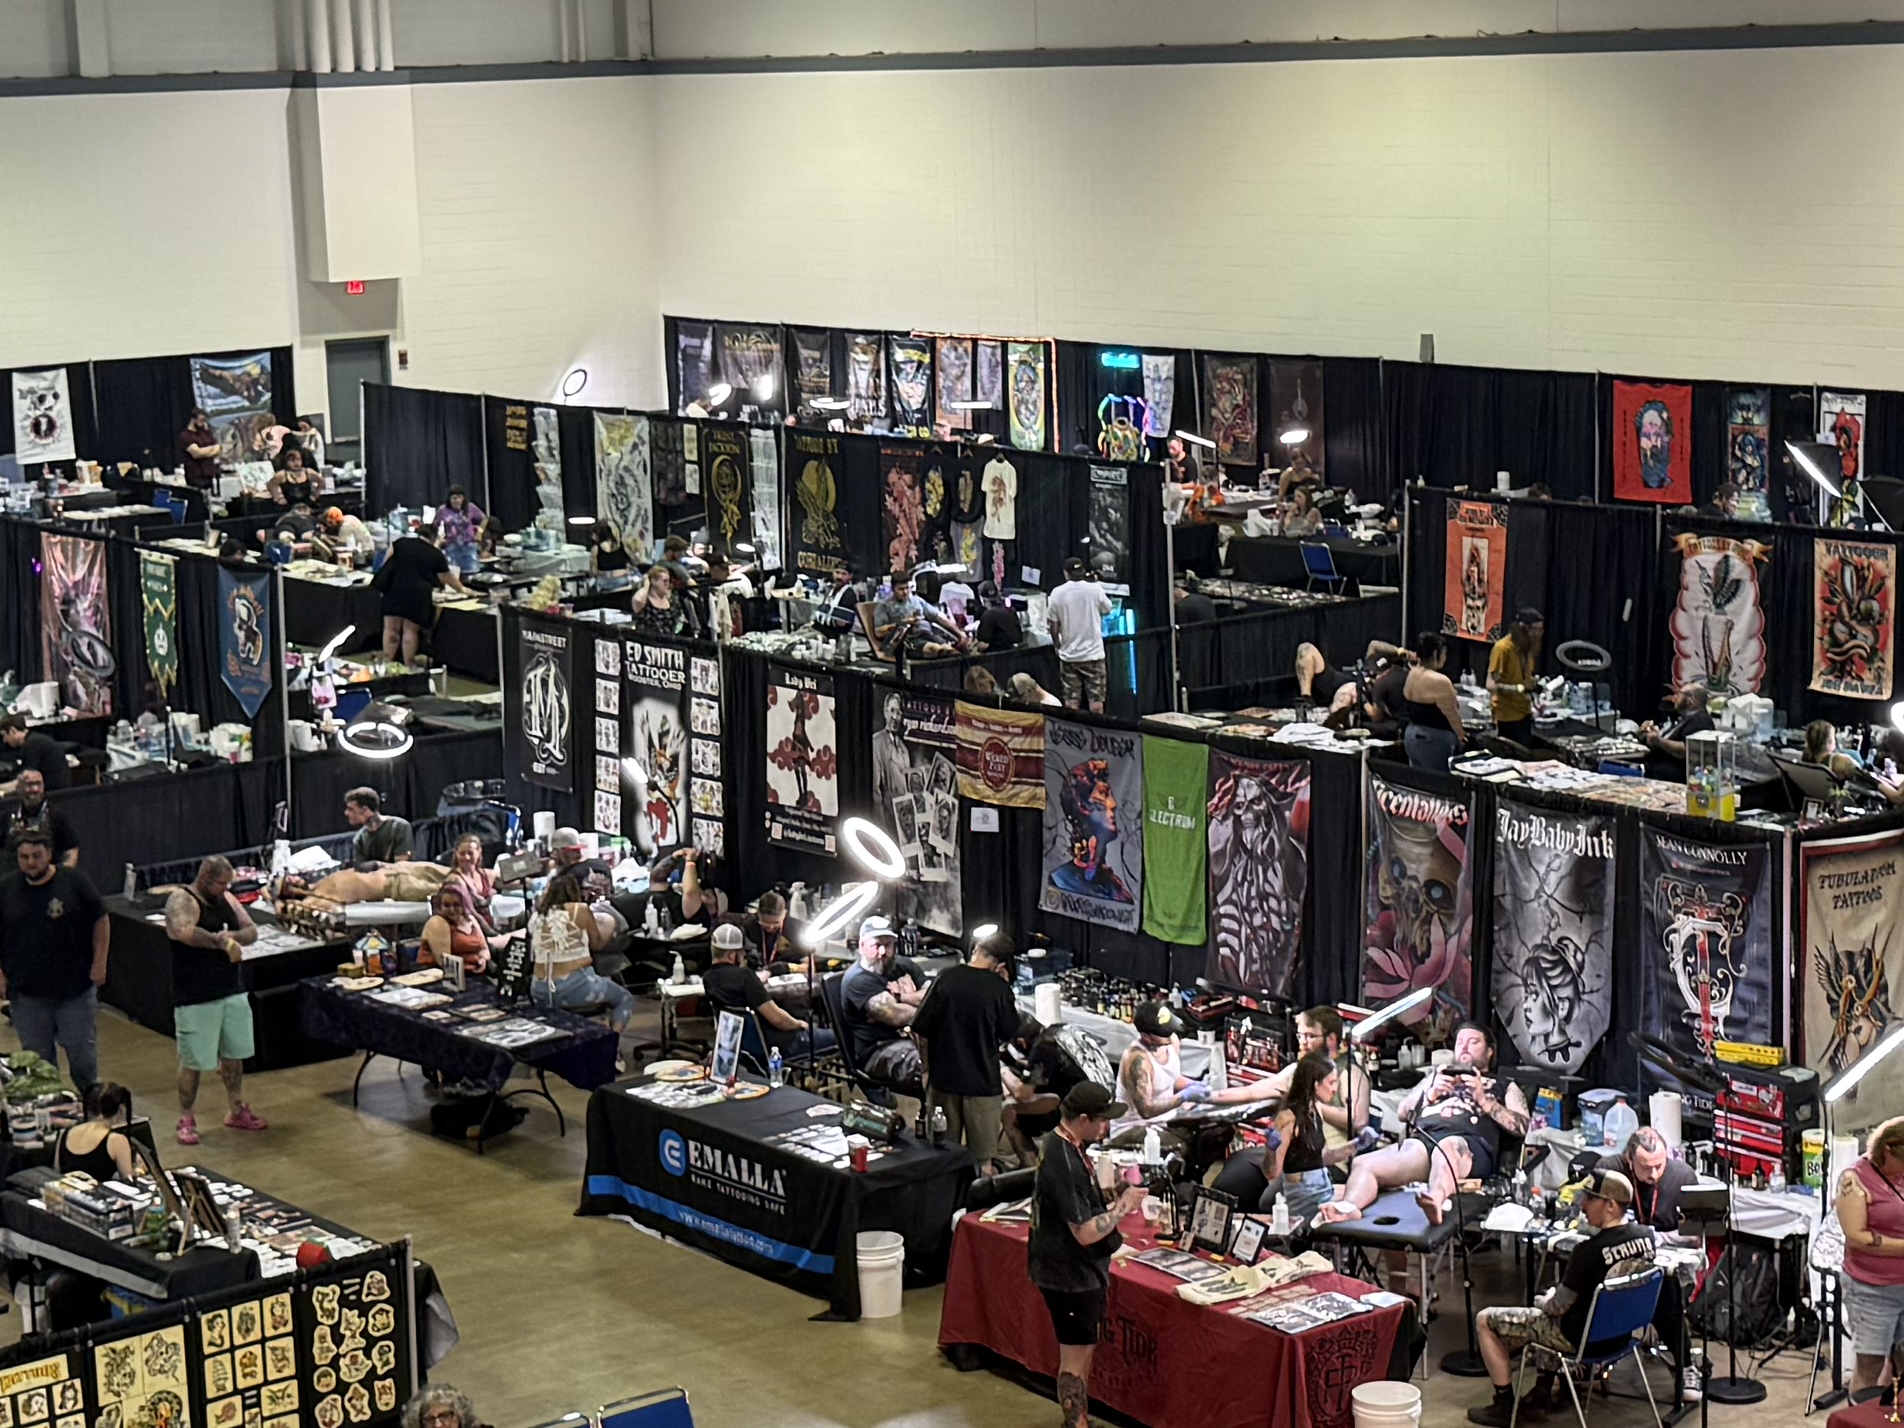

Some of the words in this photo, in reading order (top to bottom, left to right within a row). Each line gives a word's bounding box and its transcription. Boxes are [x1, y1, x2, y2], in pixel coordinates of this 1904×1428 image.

[625, 640, 643, 662] ED
[643, 645, 685, 671] SMITH
[624, 660, 687, 685] TATTOOER
[687, 1138, 786, 1198] EMALLA
